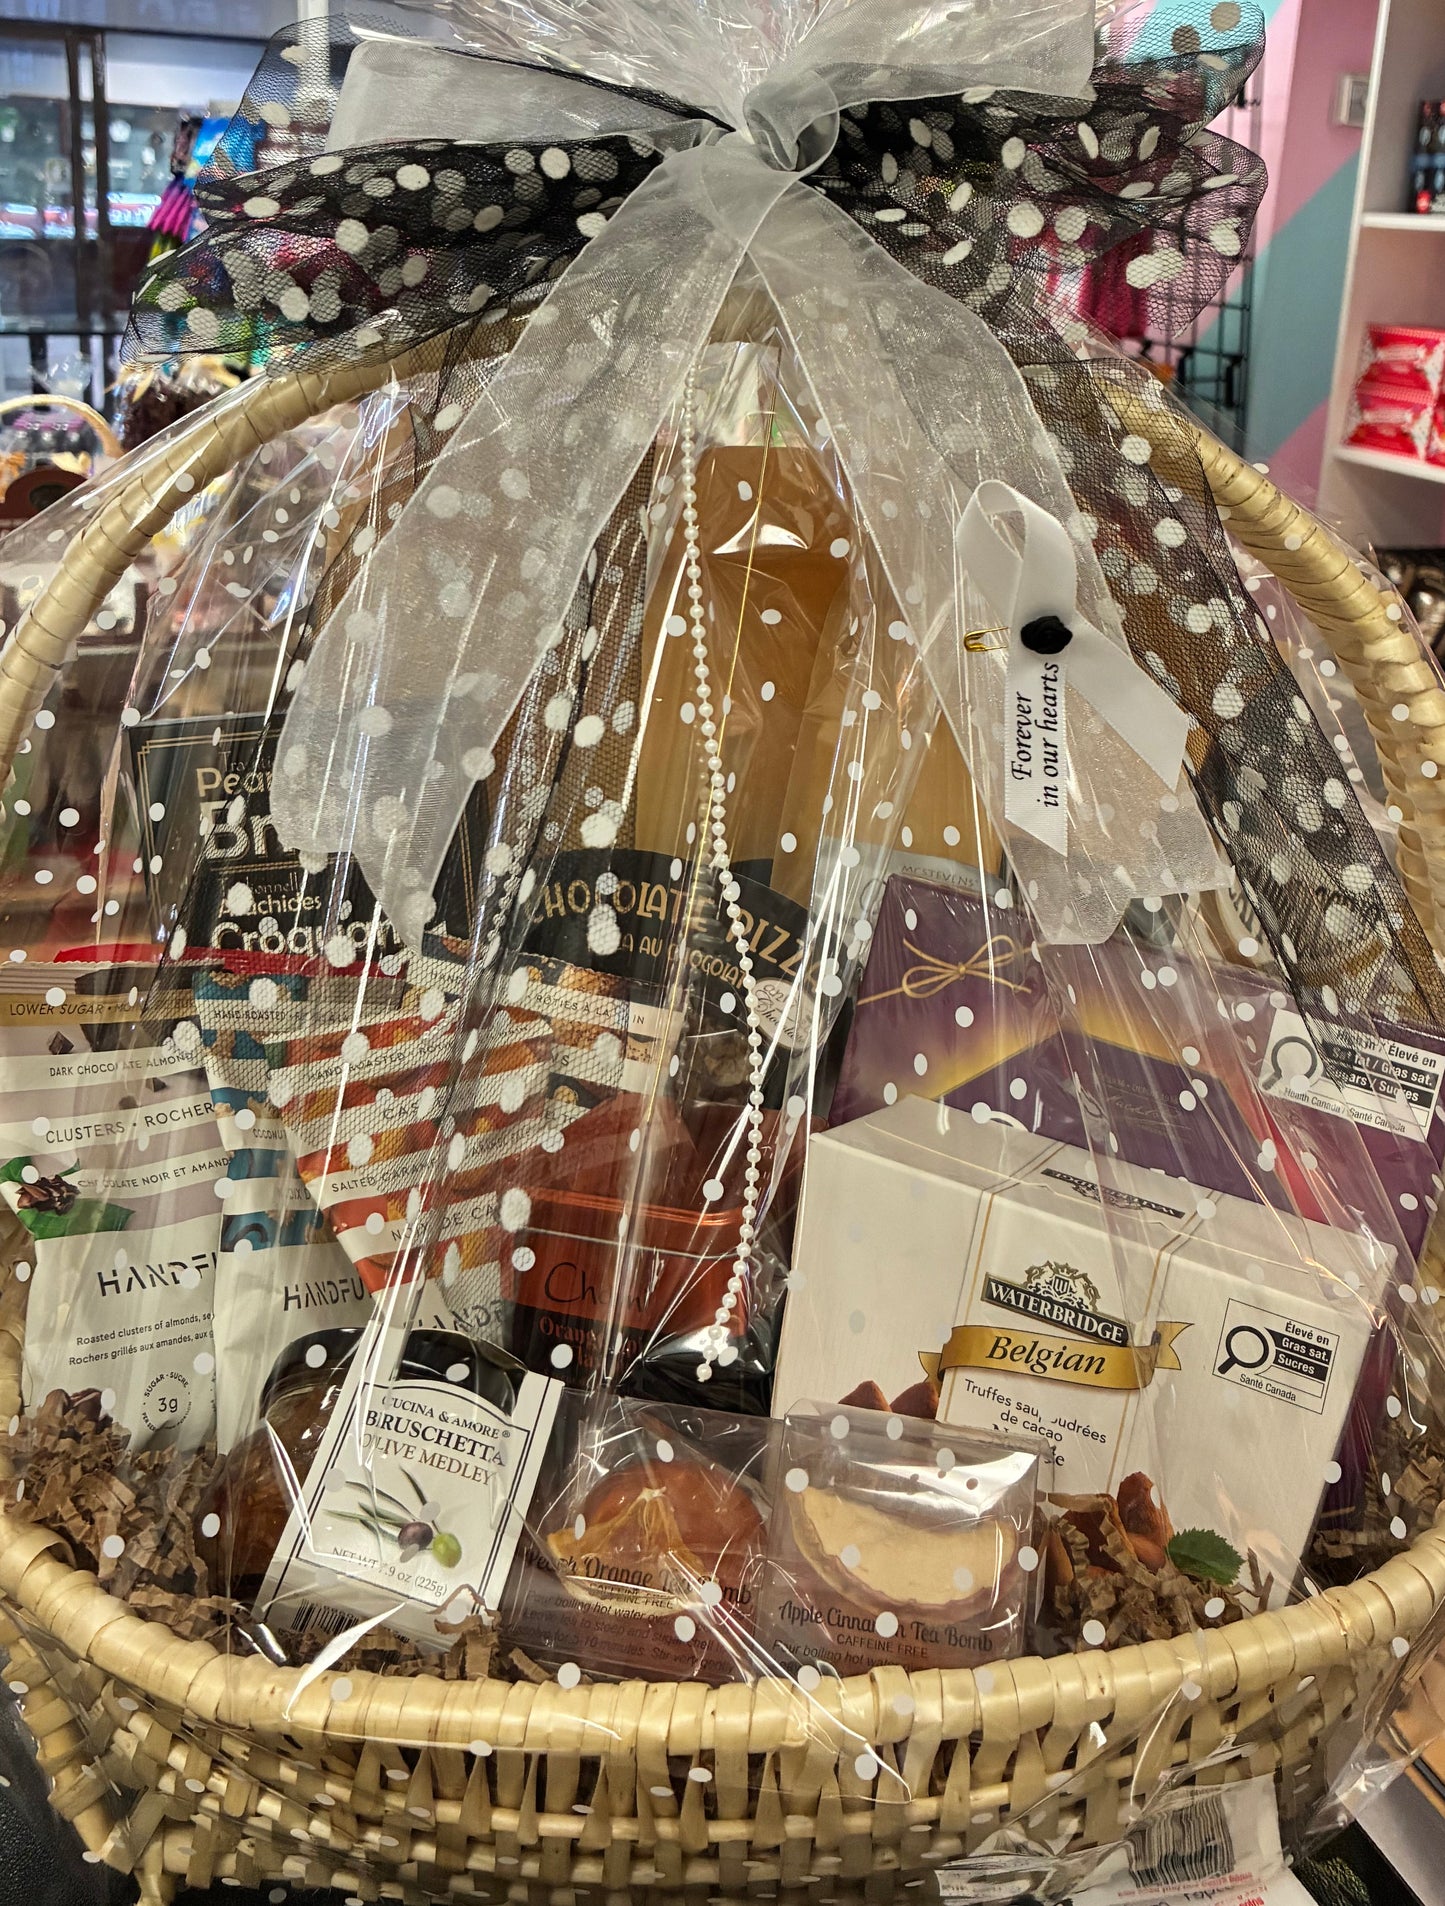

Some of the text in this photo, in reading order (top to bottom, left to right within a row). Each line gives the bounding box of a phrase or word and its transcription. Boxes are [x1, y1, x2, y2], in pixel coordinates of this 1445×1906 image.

[1011, 691, 1033, 781] Forever
[1034, 662, 1059, 808] in our hearts
[639, 937, 663, 958] AU
[10, 1003, 54, 1016] LOWER
[60, 1003, 104, 1016] SUGAR
[1388, 1043, 1419, 1063] Élevé
[1422, 1057, 1437, 1068] en
[50, 1064, 74, 1077] DARK
[1381, 1061, 1408, 1079] Gras
[1410, 1073, 1433, 1087] sat.
[1379, 1081, 1420, 1102] Suces
[1349, 1107, 1373, 1121] Santé
[46, 1121, 125, 1145] CLUSTERS
[142, 1171, 170, 1186] NOIR
[174, 1166, 186, 1178] ET
[191, 1156, 230, 1174] AMAND
[331, 1173, 377, 1193] SALTED
[283, 1279, 372, 1312] HANDFU
[990, 1281, 1125, 1344] WATERBRIDGE
[76, 1330, 116, 1347] Roasted
[117, 1322, 152, 1339] clusters
[154, 1319, 164, 1330] of
[165, 1313, 201, 1329] almonds,
[1284, 1320, 1329, 1346] Élevé en
[69, 1349, 109, 1366] Rochers
[111, 1342, 138, 1360] grillés
[139, 1342, 154, 1352] aux
[155, 1333, 194, 1350] amandes,
[194, 1330, 208, 1341] aux
[985, 1335, 1106, 1375] Belgian
[1282, 1337, 1329, 1362] Gras sat.
[1277, 1353, 1315, 1375] Sucres
[144, 1371, 189, 1397] SUGAR SUCRE
[1239, 1373, 1297, 1402] Santé Canada
[158, 1397, 178, 1413] 3g
[438, 1411, 450, 1424] &
[965, 1378, 1107, 1444] Truffes sauudrées
[365, 1410, 506, 1467] BRUSCHETTA
[1000, 1410, 1018, 1425] de
[1022, 1419, 1063, 1443] cacao
[418, 1448, 498, 1486] MEDLEY
[332, 1546, 356, 1560] NET
[397, 1572, 412, 1583] oz
[414, 1575, 448, 1597] (225g)
[582, 1552, 653, 1588] Orange
[592, 1601, 612, 1614] hot
[779, 1600, 993, 1653] Apple Cinnan Tea Bomb
[773, 1639, 801, 1655] Pour
[844, 1651, 863, 1665] hot
[836, 1634, 929, 1659] CAFFEINE FREE
